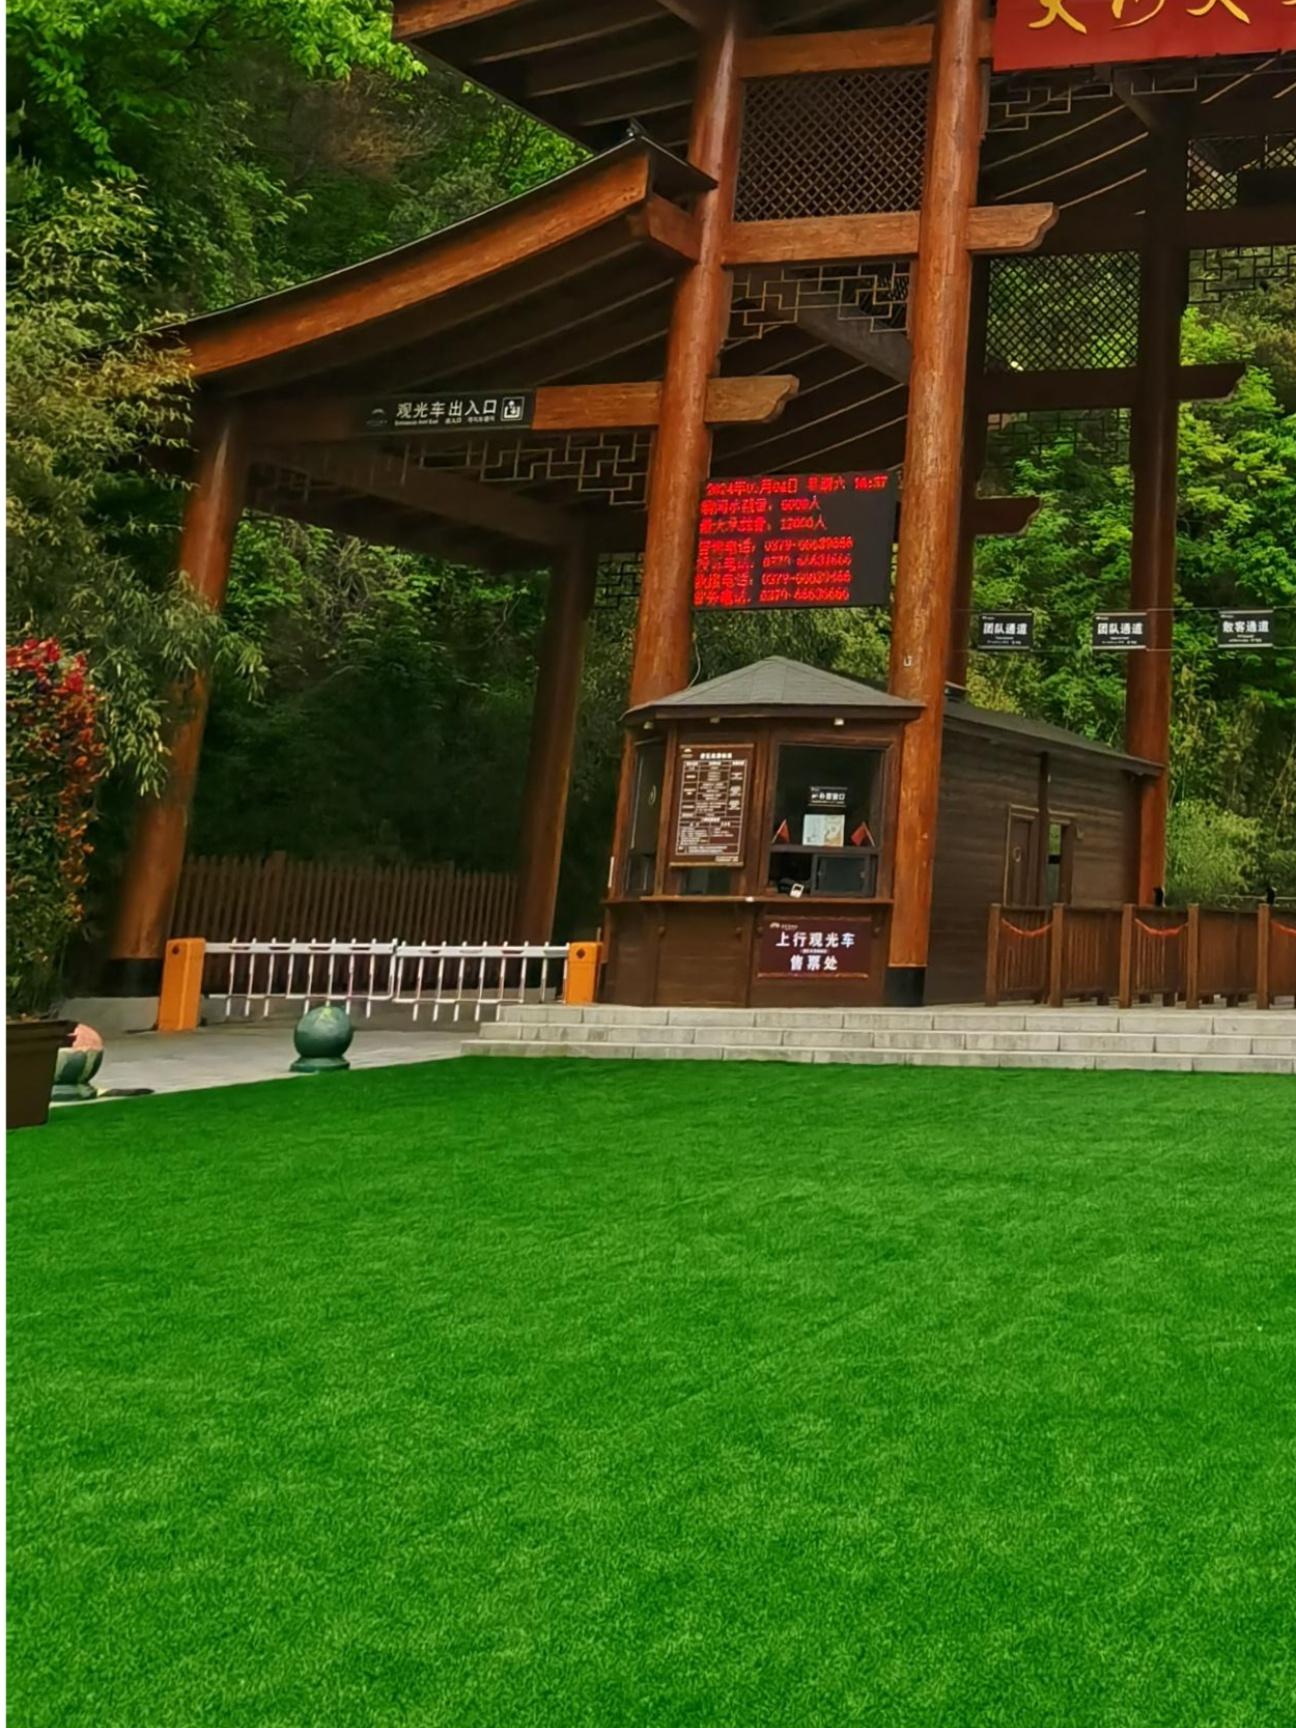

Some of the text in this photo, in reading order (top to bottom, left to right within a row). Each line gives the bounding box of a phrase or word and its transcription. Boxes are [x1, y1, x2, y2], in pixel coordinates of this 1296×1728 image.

[396, 399, 498, 419] 观光车出入口
[983, 622, 1028, 635] 团队通道
[1097, 622, 1143, 635] 团队通道
[776, 931, 856, 948] 上行观光车
[790, 954, 838, 971] 售票处
